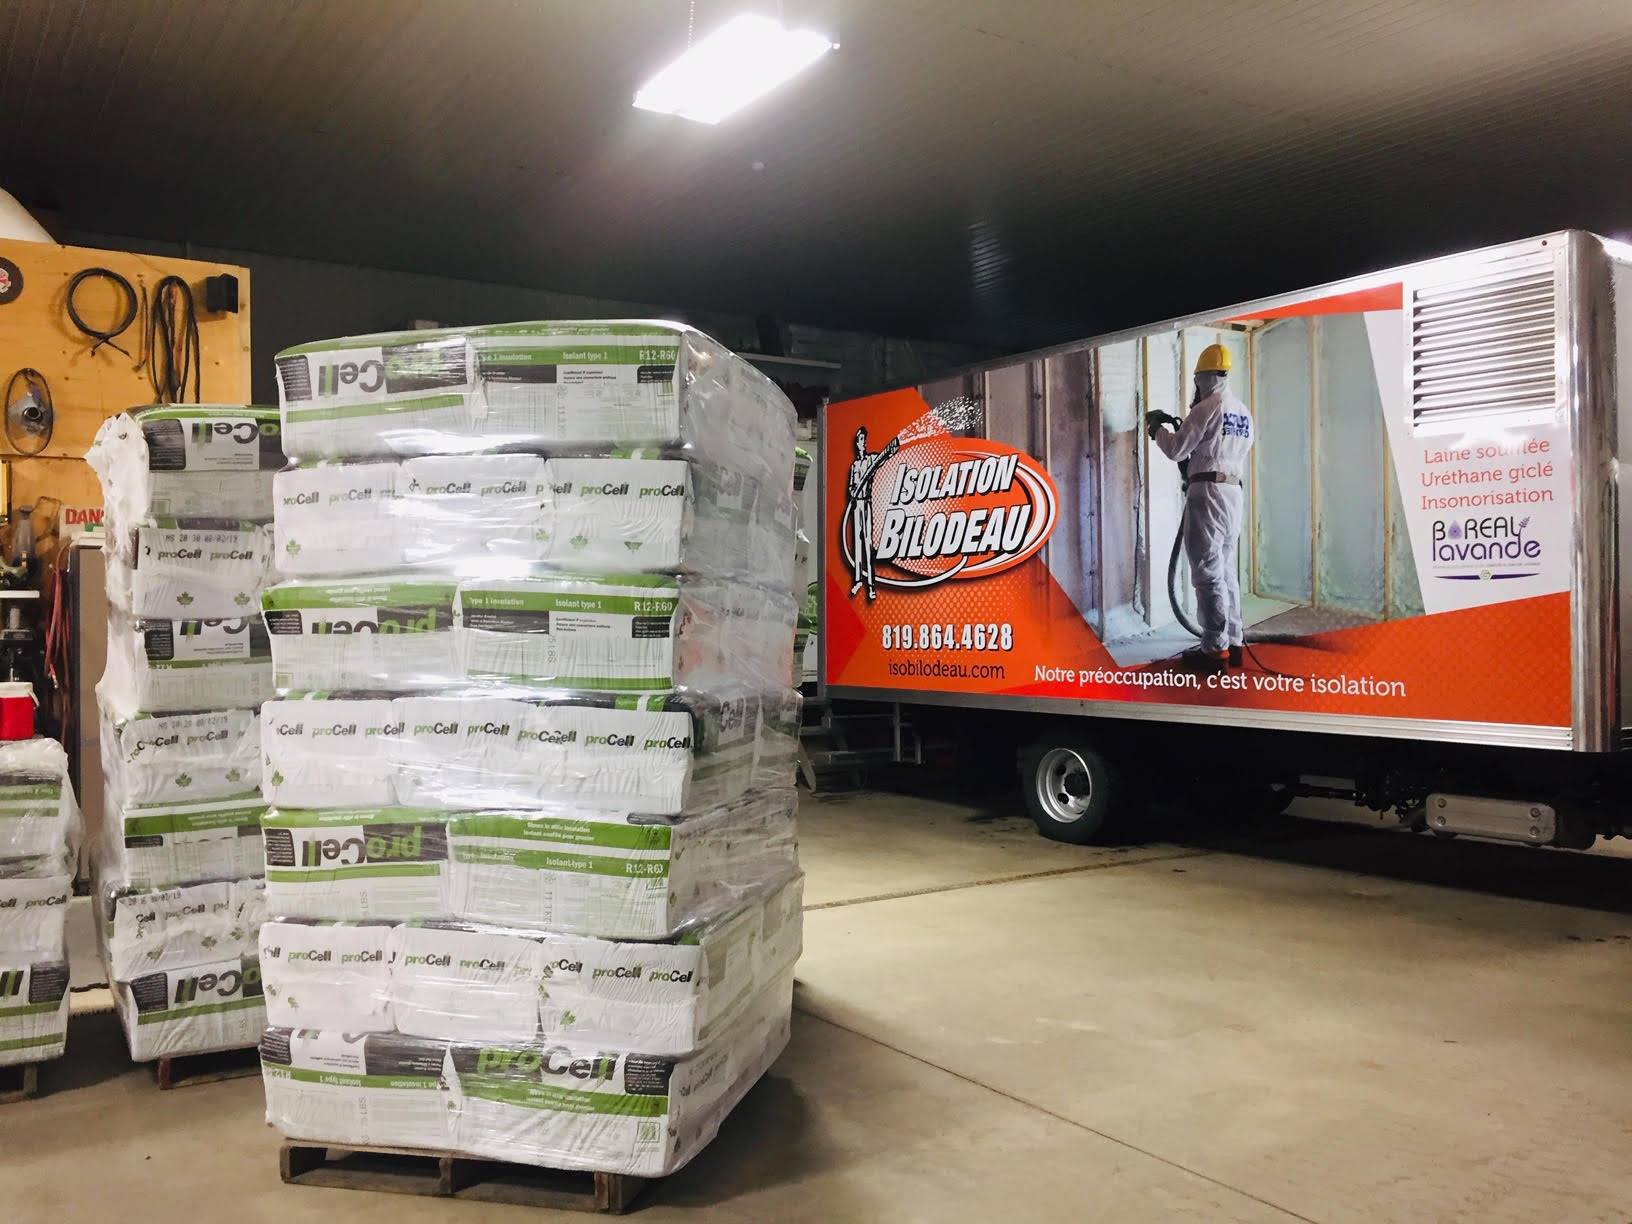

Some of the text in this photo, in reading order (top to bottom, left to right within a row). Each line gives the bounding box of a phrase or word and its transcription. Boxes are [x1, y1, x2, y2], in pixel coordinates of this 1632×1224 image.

[1424, 447, 1471, 464] Laine
[890, 454, 1018, 505] ISOLATION
[1421, 461, 1553, 487] Uréthane giclé
[580, 483, 629, 498] proCell
[639, 484, 685, 498] proCell
[1421, 488, 1554, 510] Insonorisation
[65, 508, 104, 525] DAN
[875, 504, 1033, 561] BILODEAU
[158, 548, 254, 561] proCell proCell
[1432, 533, 1541, 561] lavande
[556, 599, 580, 608] Isolant
[581, 601, 596, 610] type
[881, 623, 1013, 651] 819.864.4628
[888, 659, 1005, 680] isobilodeau.com
[1035, 665, 1406, 698] Notre préoccupation, c'est votre isolation
[187, 729, 228, 745] proCell
[312, 724, 357, 738] proCell
[365, 722, 405, 737] proCell
[414, 722, 459, 736] proCell
[584, 733, 634, 747] proCell
[644, 736, 691, 750] proCell
[302, 825, 421, 867] proCell
[288, 949, 331, 962] proCell
[341, 949, 383, 962] proCell
[405, 953, 451, 967] proCell
[592, 966, 642, 979] proCell
[649, 968, 695, 983] proCel
